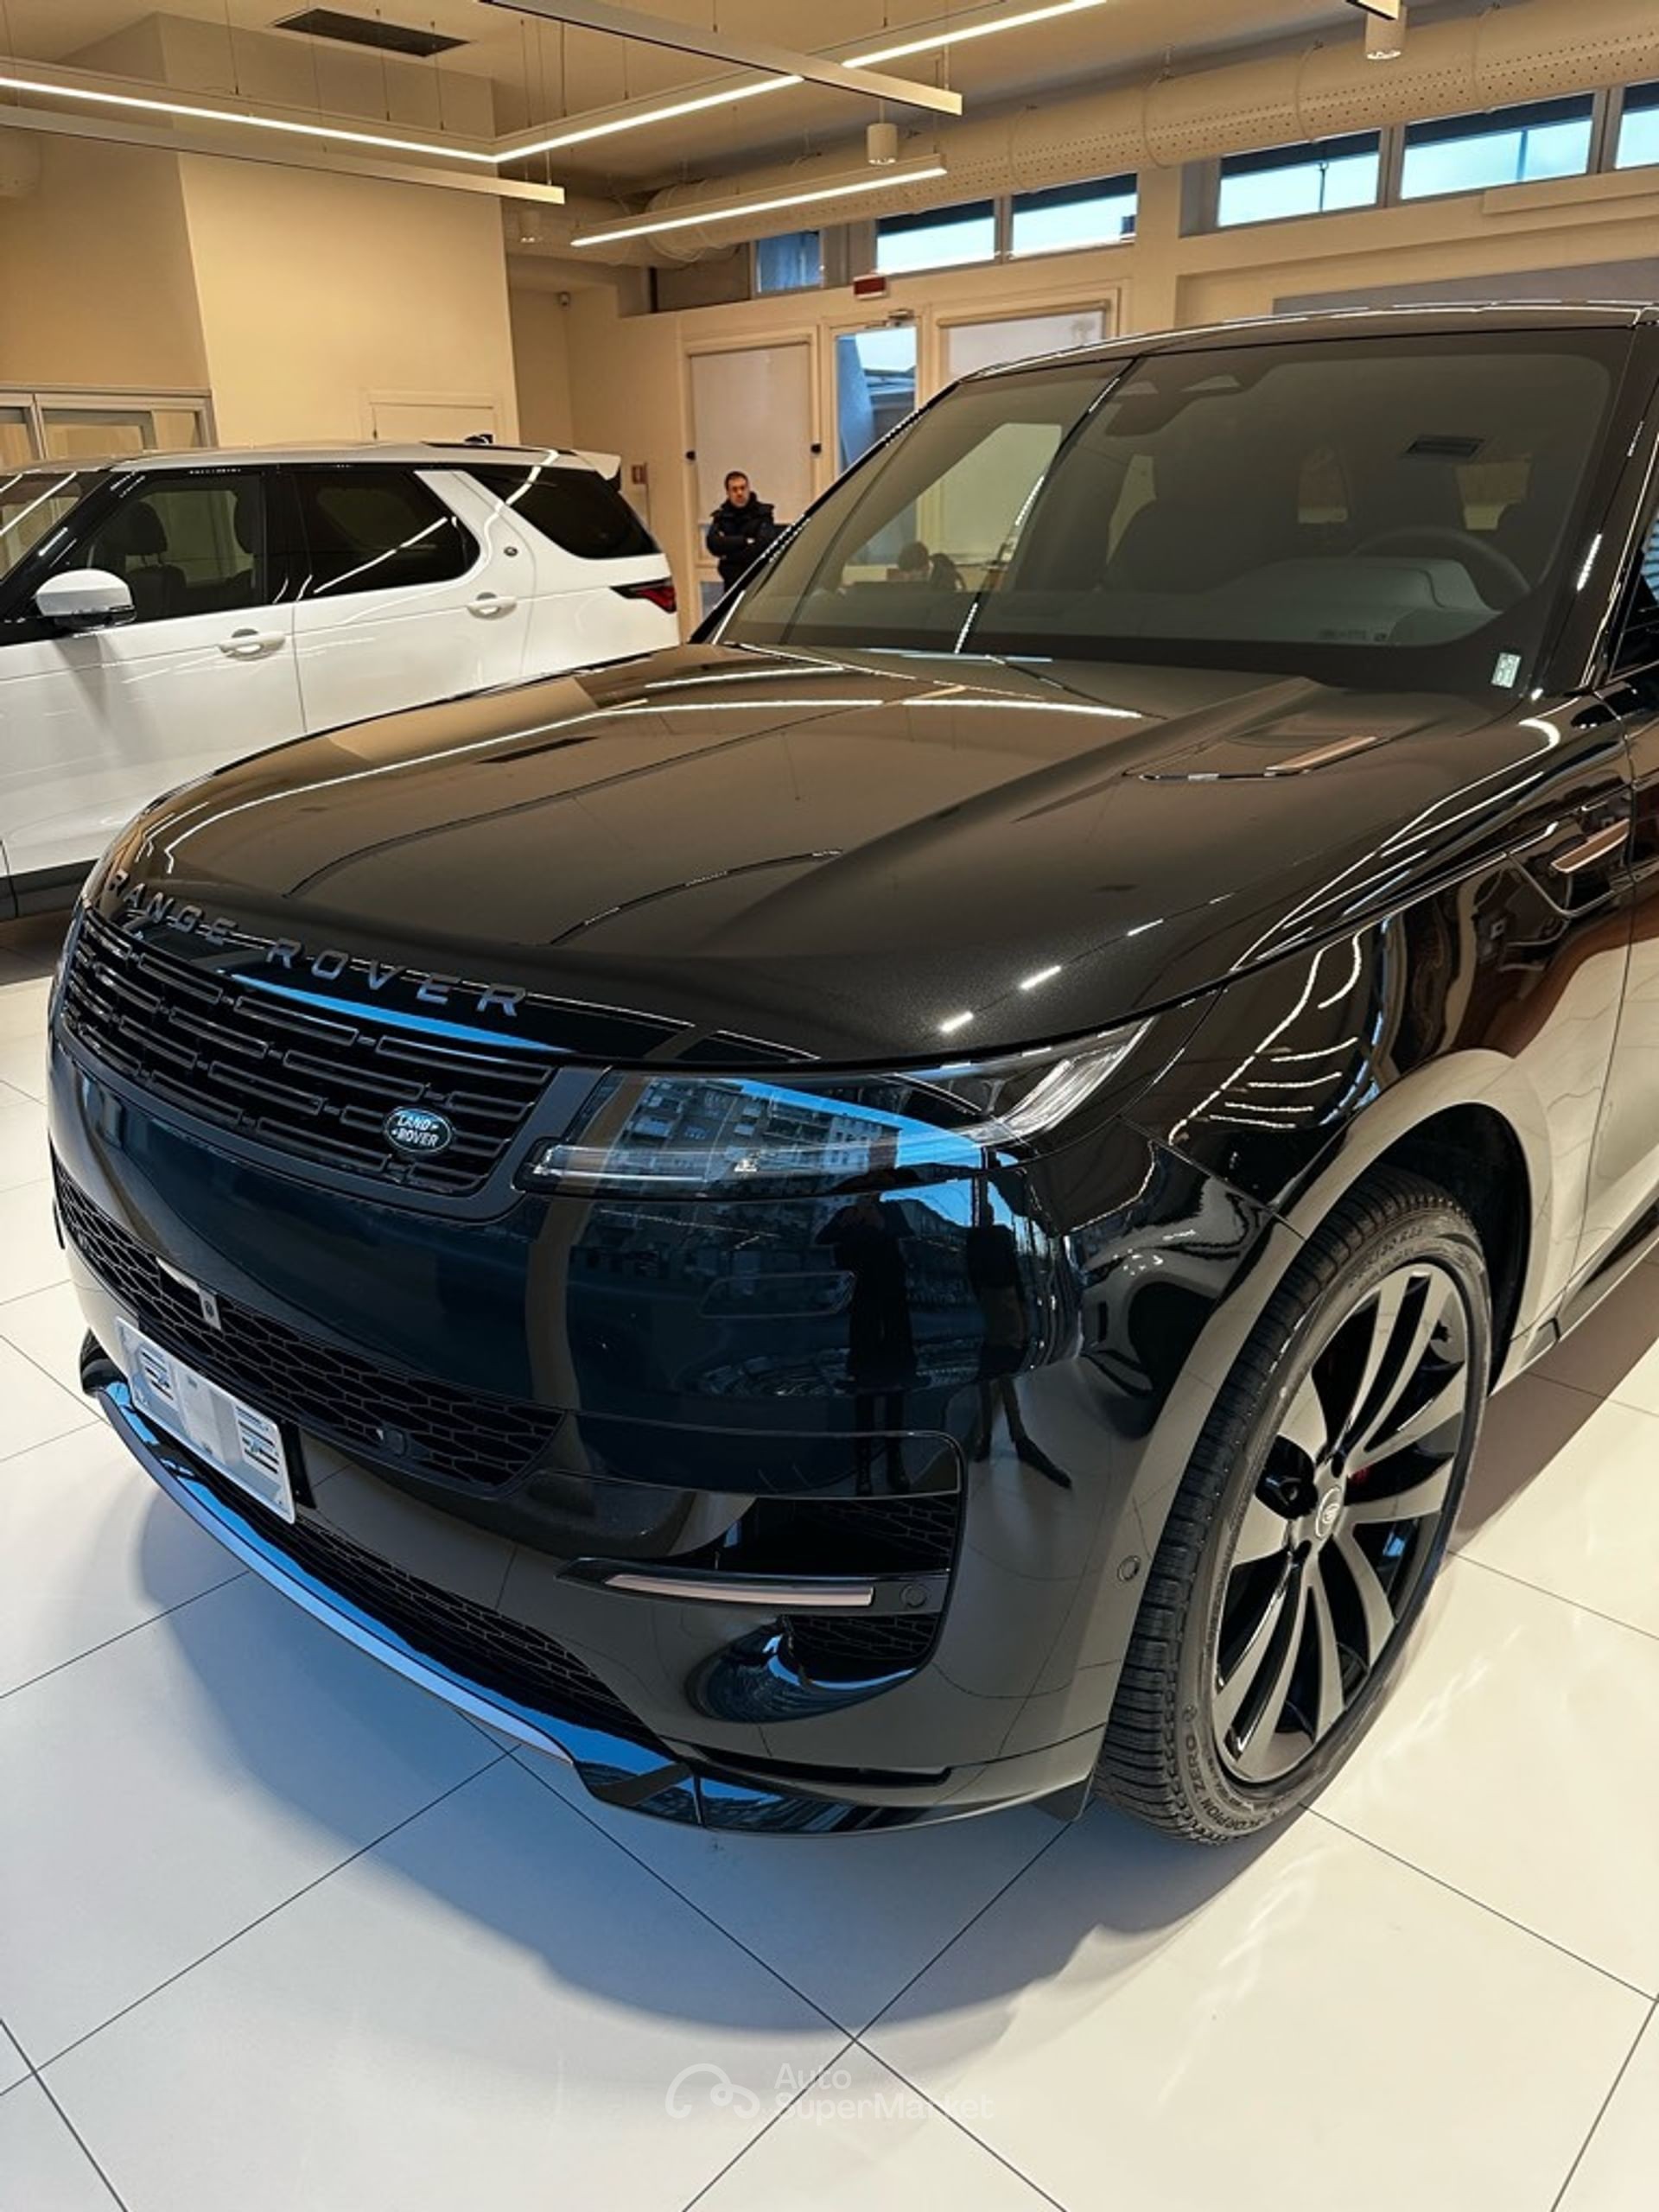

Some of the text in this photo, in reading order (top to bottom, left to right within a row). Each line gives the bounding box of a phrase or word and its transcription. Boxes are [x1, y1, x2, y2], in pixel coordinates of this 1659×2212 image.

[106, 868, 528, 1018] RANGE ROVER
[397, 1114, 432, 1131] LAND
[397, 1127, 439, 1147] ROVER
[1185, 1735, 1206, 1794] ZERO
